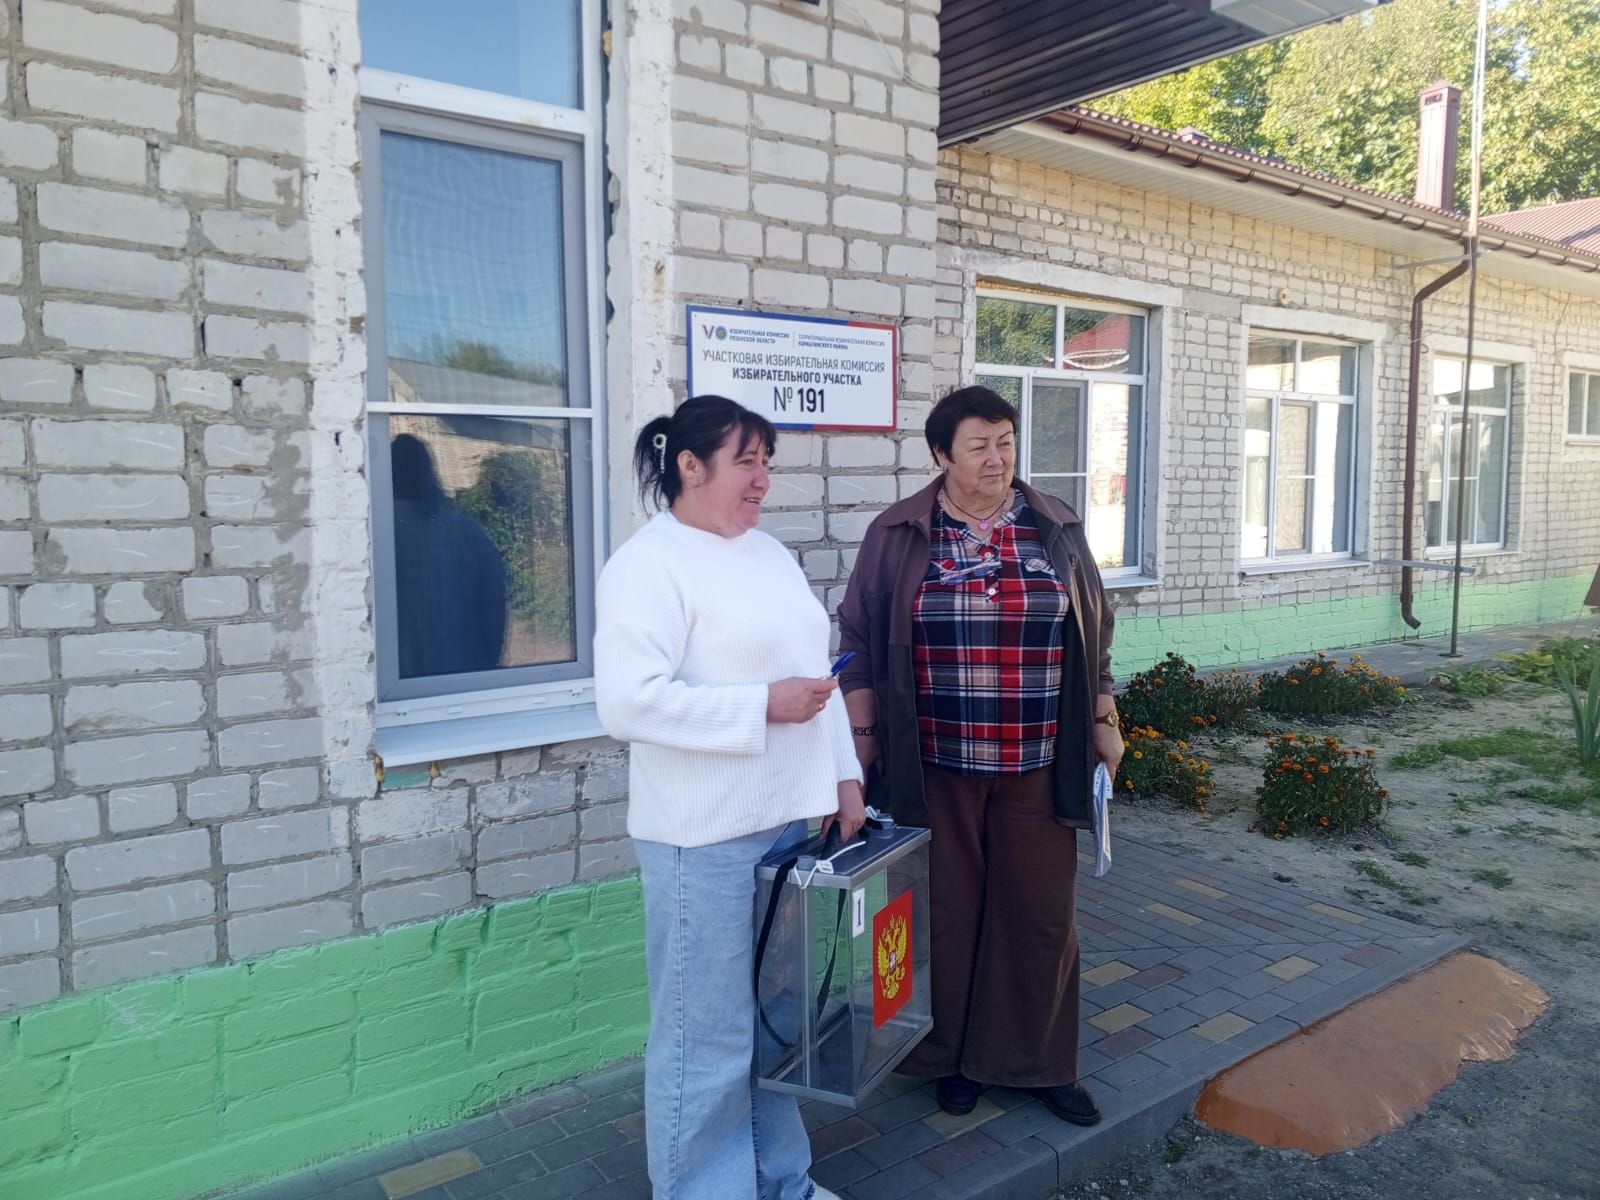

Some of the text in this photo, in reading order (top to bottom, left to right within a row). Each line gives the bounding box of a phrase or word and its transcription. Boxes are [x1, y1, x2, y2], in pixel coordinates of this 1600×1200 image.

[703, 349, 885, 373] УЧАСТКОВАЯ ИЗБИРАТЕЛЬНАЯ КОМИССИЯ
[732, 367, 862, 386] ИЗБИРАТЕЛЬНОГО УЧАСТКА
[797, 388, 825, 413] 191
